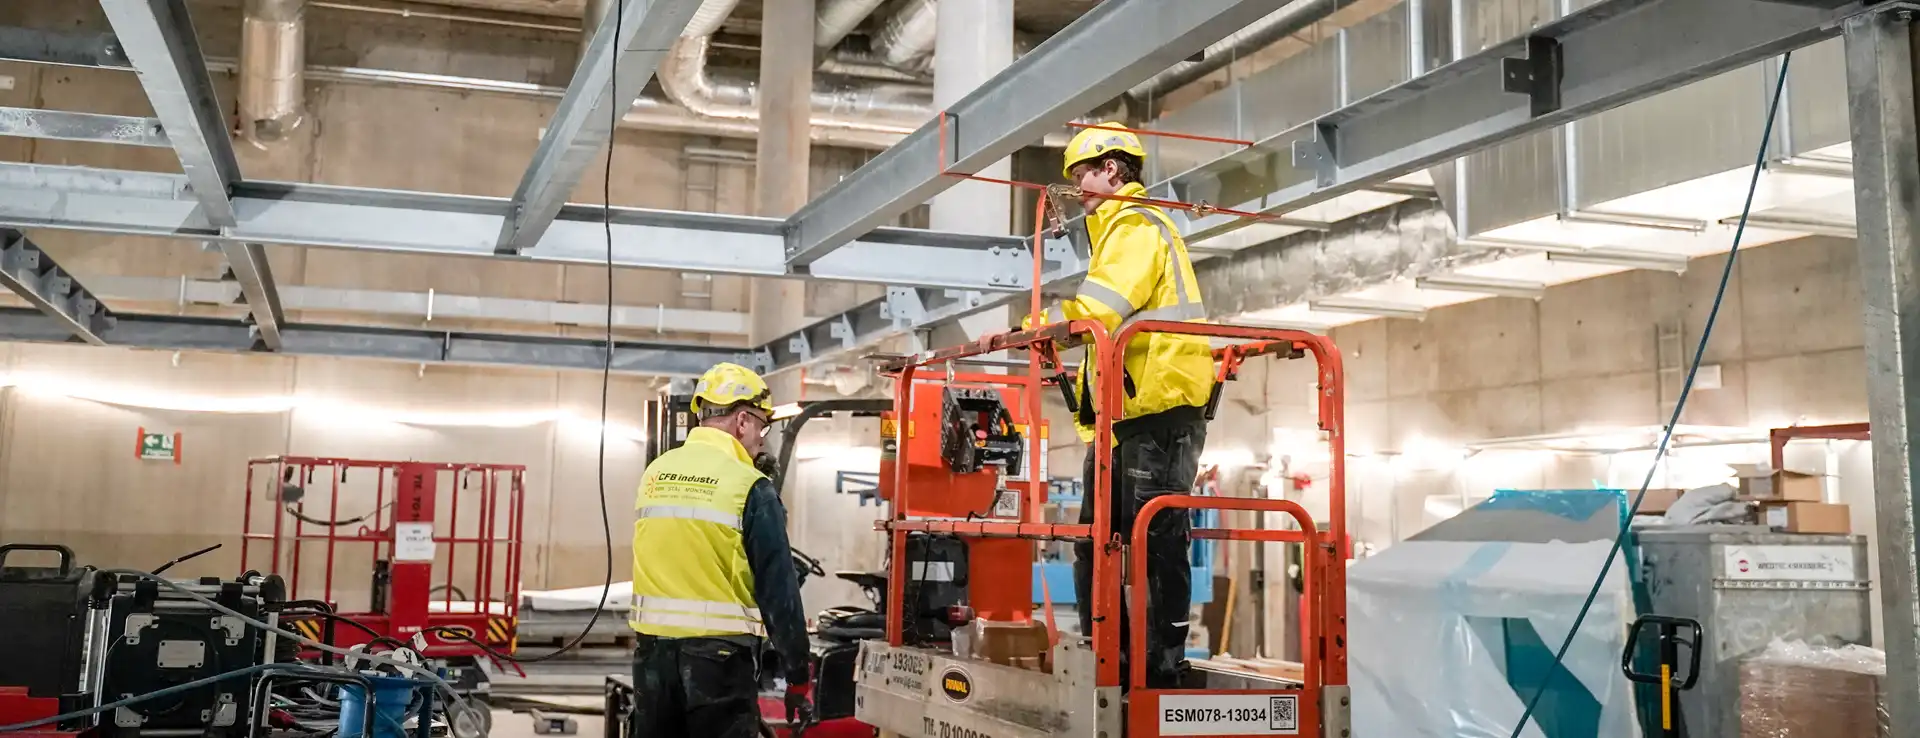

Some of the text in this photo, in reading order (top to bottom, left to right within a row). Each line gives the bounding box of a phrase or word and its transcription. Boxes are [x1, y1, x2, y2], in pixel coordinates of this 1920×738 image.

[658, 473, 719, 484] CFB industri
[1164, 708, 1267, 722] ESM078-13034
[923, 716, 937, 736] Tlf.
